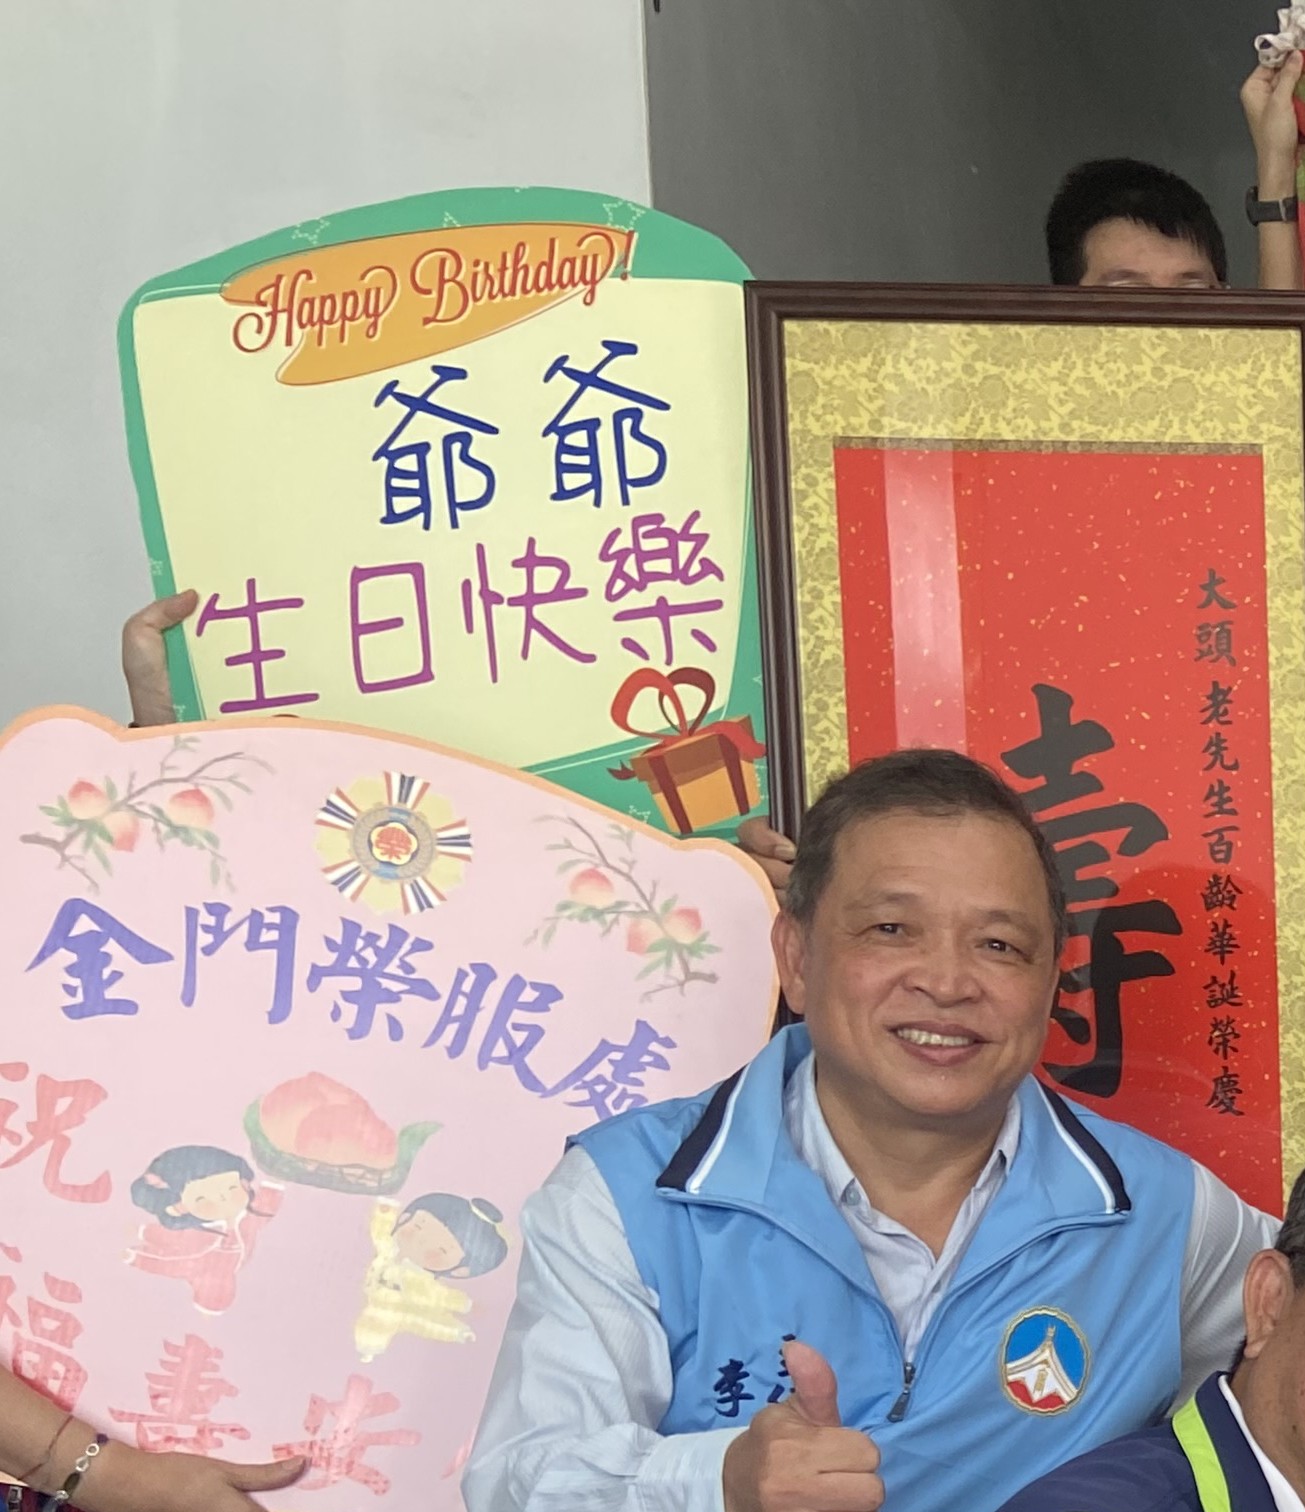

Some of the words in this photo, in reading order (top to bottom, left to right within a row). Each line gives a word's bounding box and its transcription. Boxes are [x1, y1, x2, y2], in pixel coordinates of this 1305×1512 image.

[232, 266, 397, 353] Happy
[372, 341, 671, 530] 爺爺
[197, 511, 724, 714] 生日快樂
[25, 897, 680, 1118] 金門榮服處
